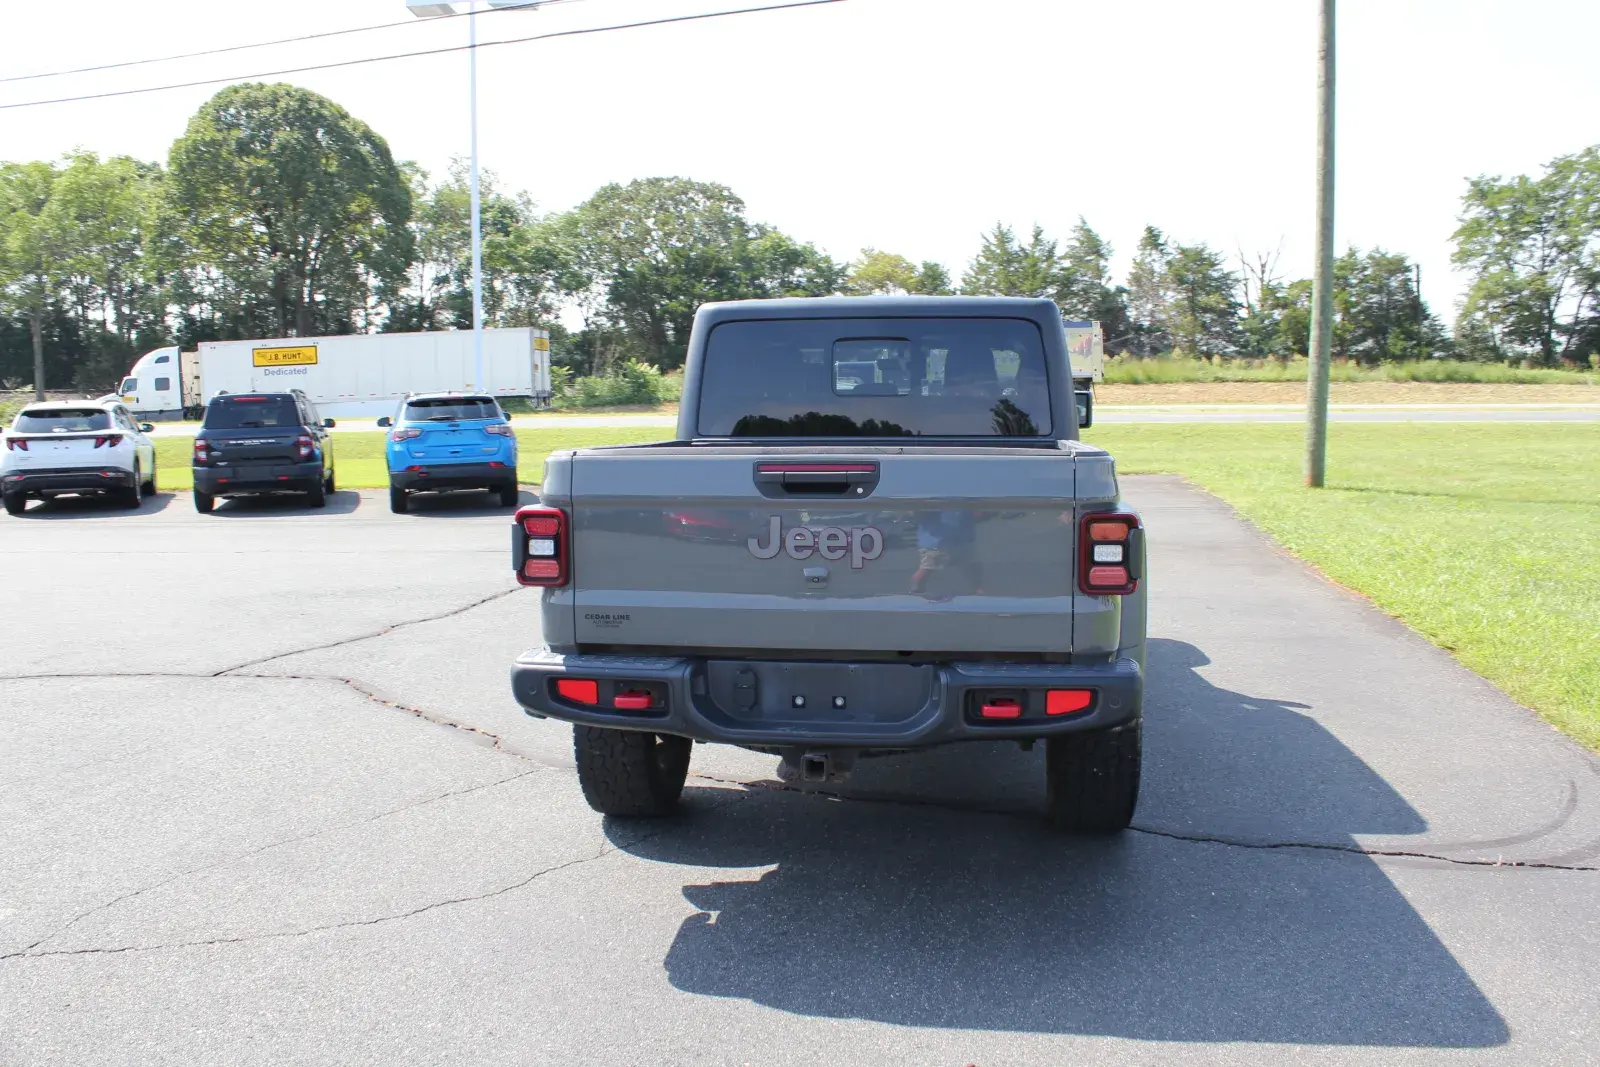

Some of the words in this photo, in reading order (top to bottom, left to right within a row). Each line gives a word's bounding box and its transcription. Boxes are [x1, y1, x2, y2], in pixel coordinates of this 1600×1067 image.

[282, 352, 301, 360] HUNT
[264, 367, 307, 376] Dedicated
[748, 515, 884, 569] Jeep
